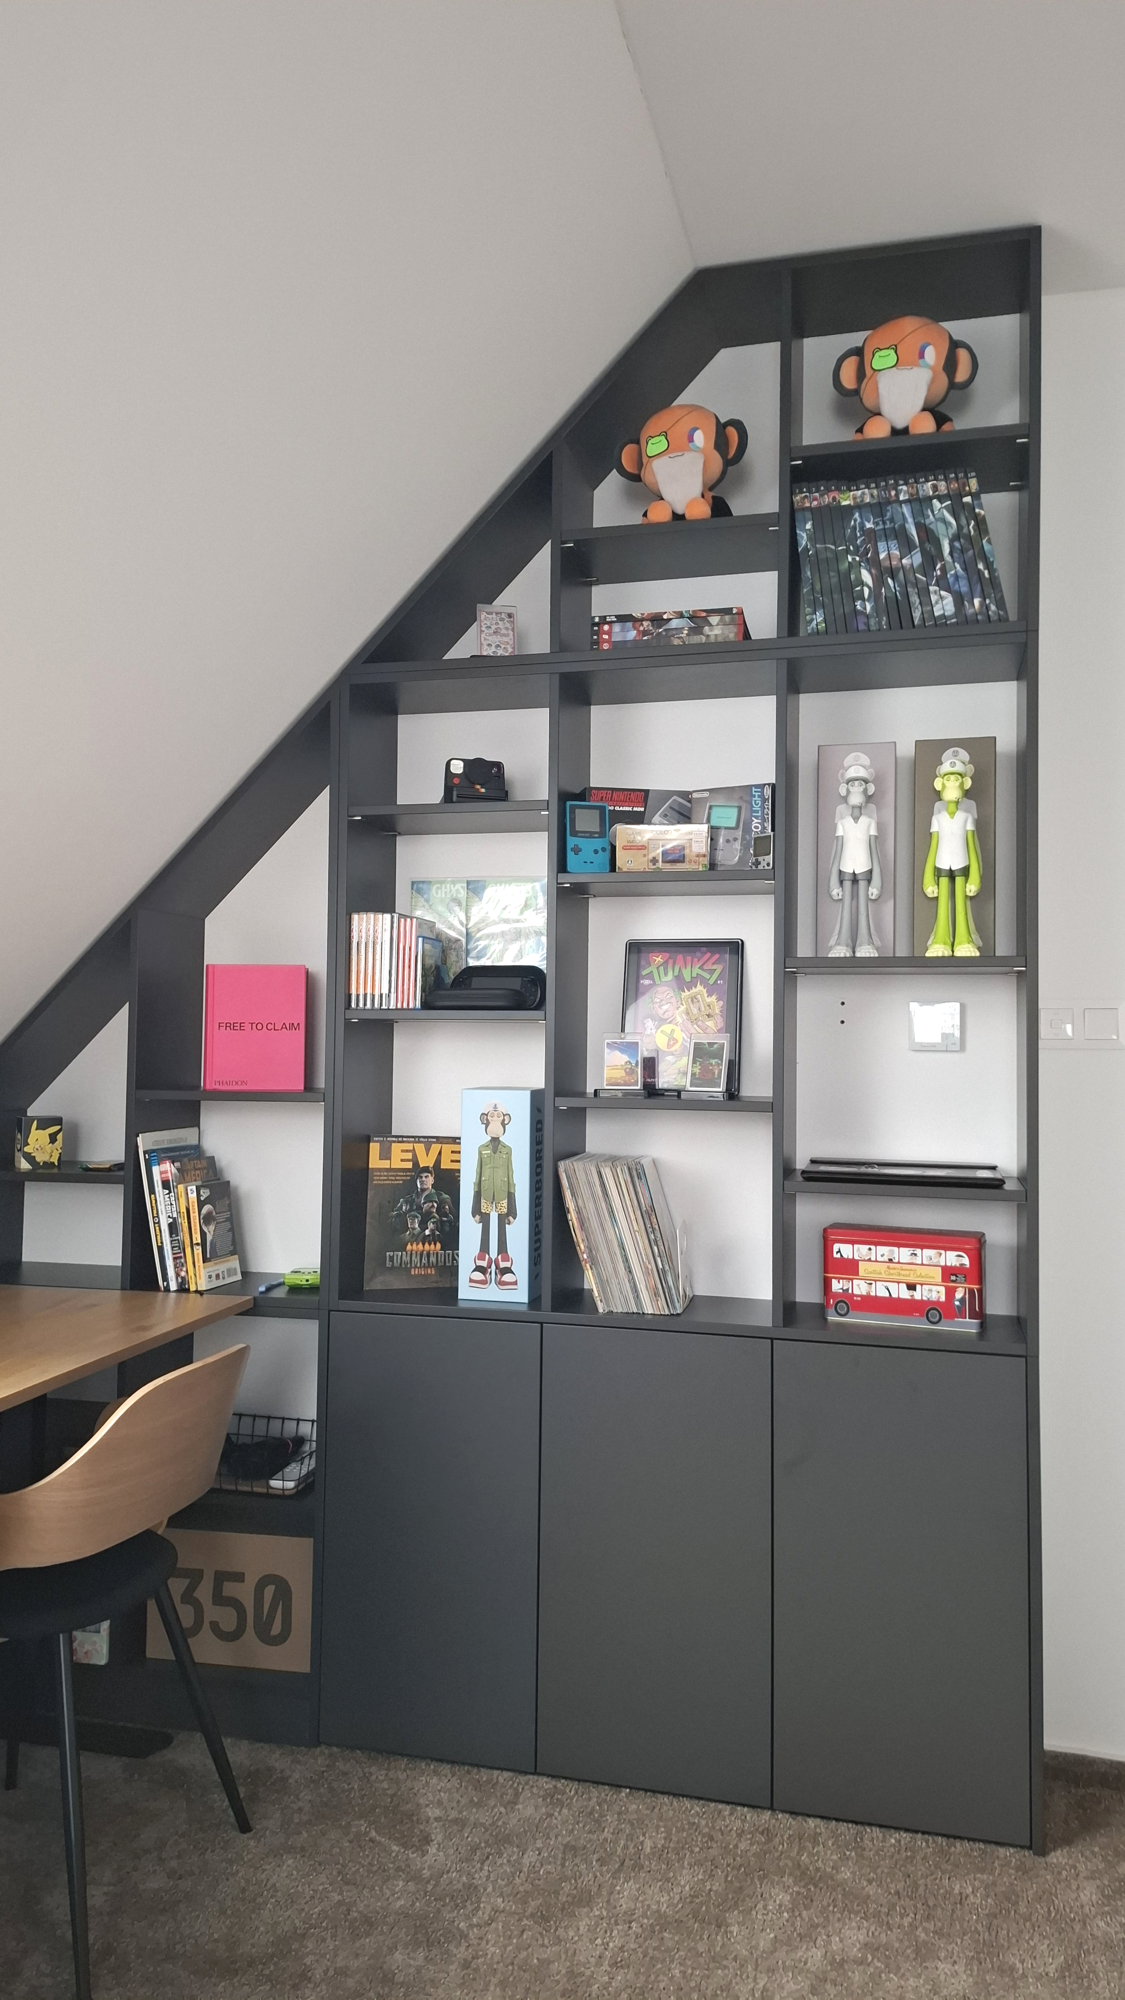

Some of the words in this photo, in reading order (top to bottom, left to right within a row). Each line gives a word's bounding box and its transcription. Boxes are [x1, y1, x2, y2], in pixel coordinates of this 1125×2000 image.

[590, 790, 611, 801] SUPER
[611, 791, 645, 802] NINTENDO
[641, 952, 724, 985] PUNKS
[218, 1022, 245, 1031] FREE
[249, 1022, 264, 1031] TO
[266, 1022, 300, 1032] CLAIM
[169, 1193, 177, 1218] CAPTAIN
[533, 1119, 543, 1267] SUPERBORED
[163, 1189, 172, 1225] AMERICA
[386, 1250, 459, 1268] COMMANDOS
[410, 1267, 435, 1275] ORIGINS
[169, 1567, 293, 1647] 350
